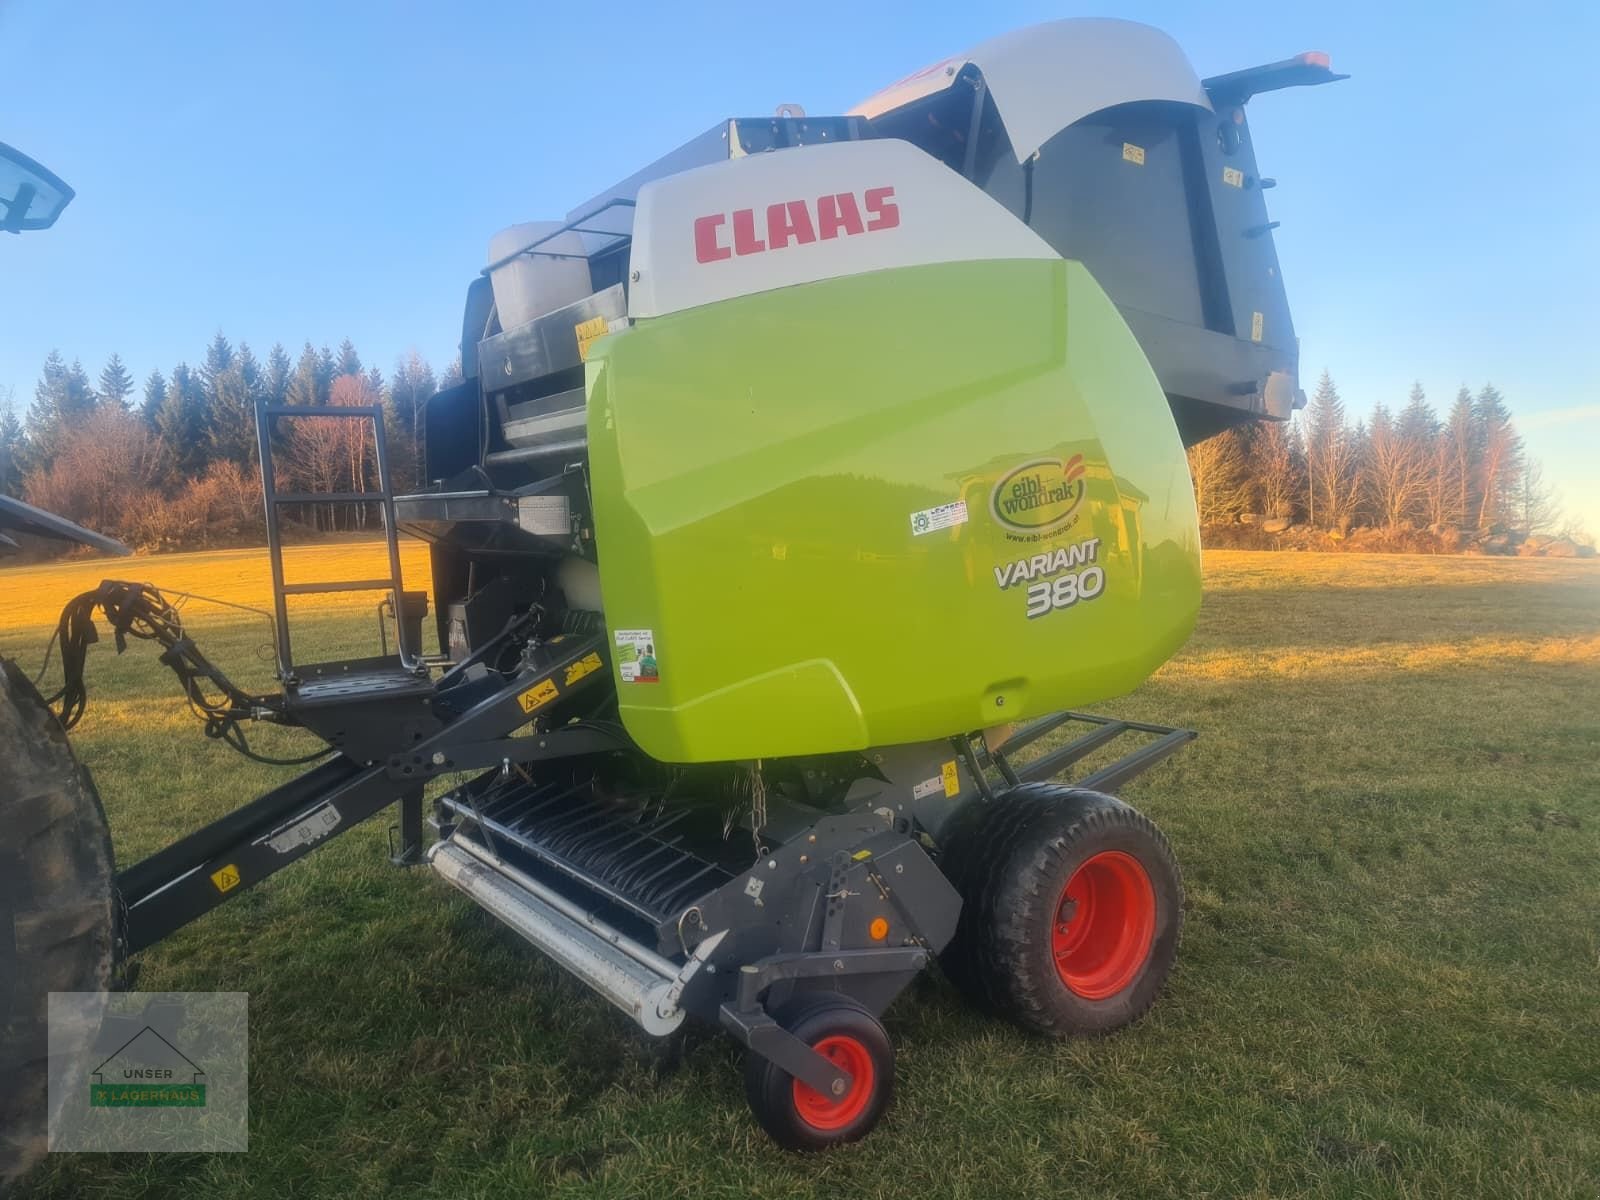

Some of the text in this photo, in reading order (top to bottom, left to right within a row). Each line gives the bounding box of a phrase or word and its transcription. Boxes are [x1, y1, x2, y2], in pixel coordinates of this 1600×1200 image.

[694, 186, 900, 264] CLAAS
[1003, 481, 1075, 515] wondrak
[1012, 473, 1042, 499] eibl
[993, 537, 1100, 591] VARIANT
[1026, 565, 1105, 619] 380
